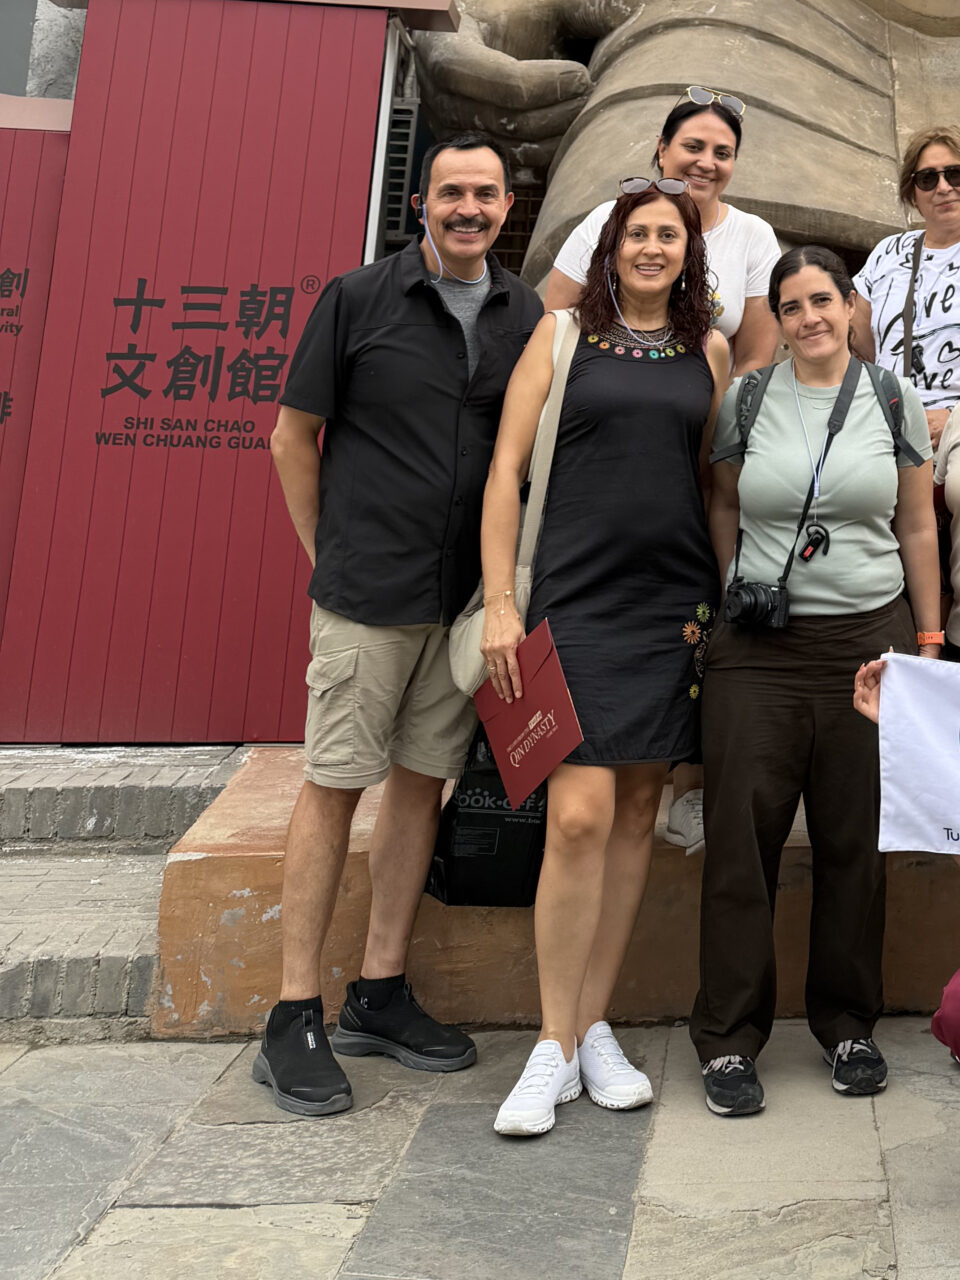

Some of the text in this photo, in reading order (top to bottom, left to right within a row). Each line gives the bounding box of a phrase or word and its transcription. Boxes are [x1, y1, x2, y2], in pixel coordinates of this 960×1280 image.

[113, 278, 295, 340] 十三朝
[101, 343, 289, 405] 文創館
[95, 432, 137, 446] WEN
[143, 434, 221, 448] CHUANG
[124, 417, 255, 433] SHI SAN CHAO
